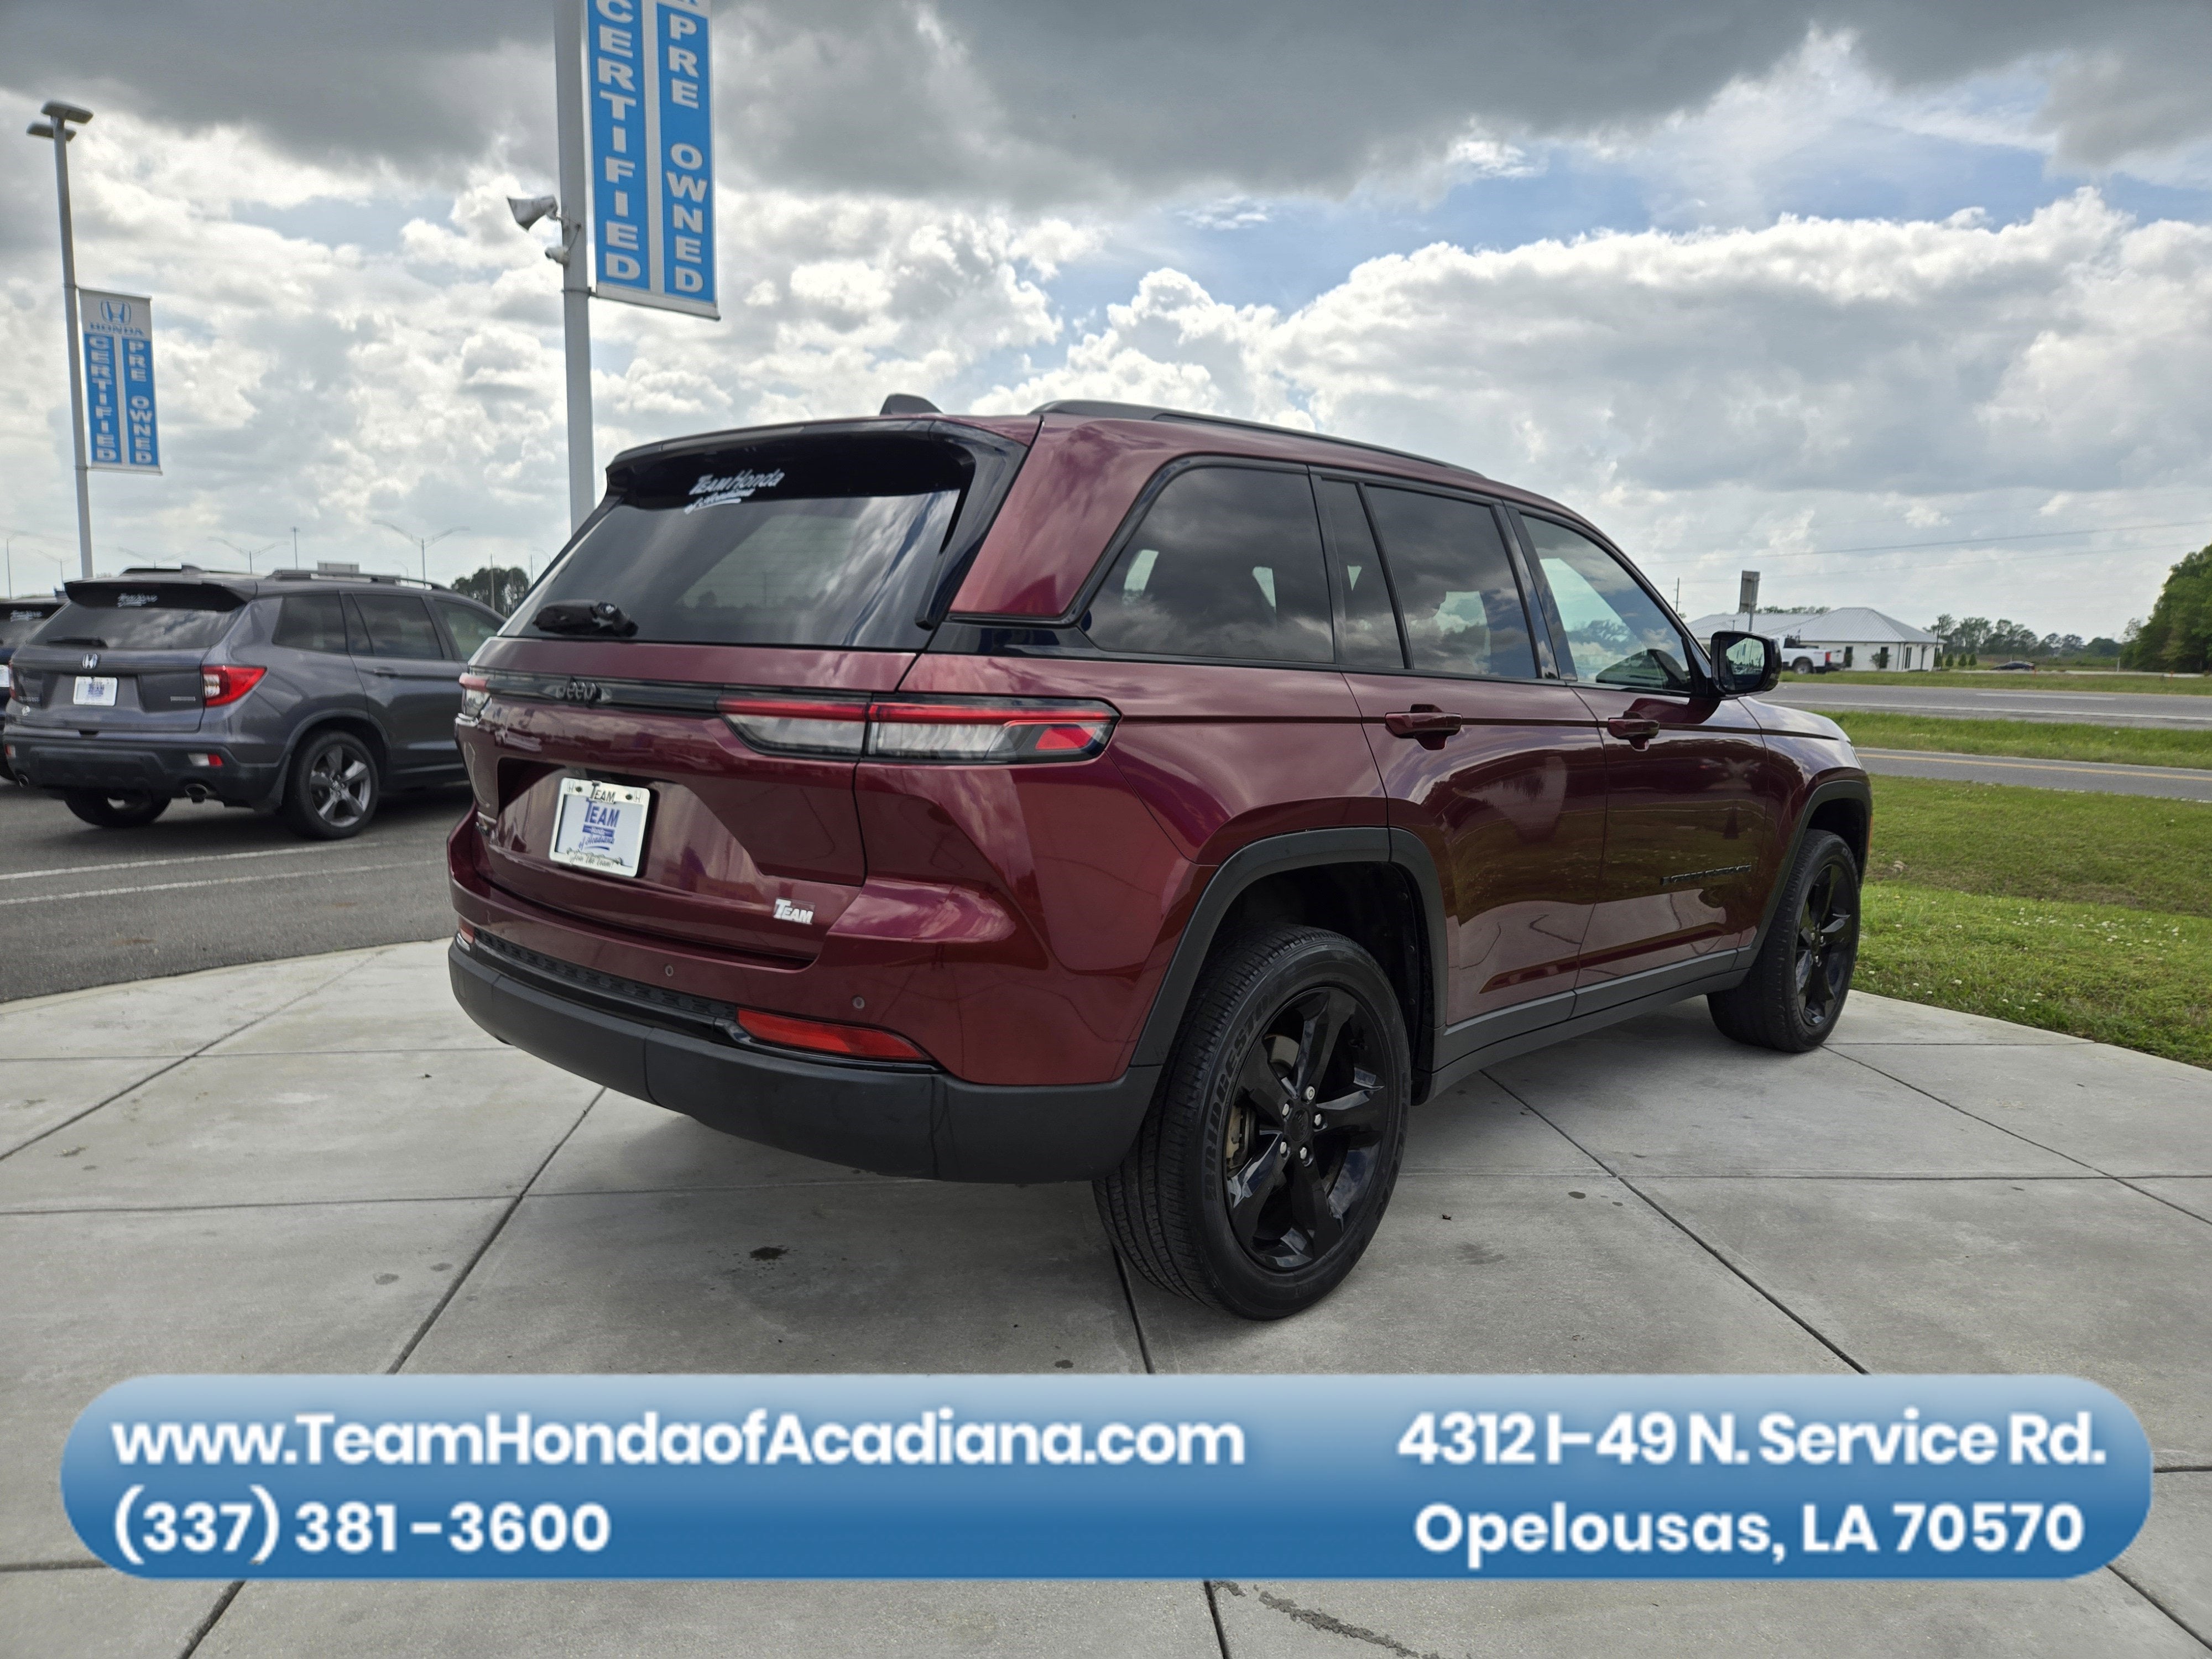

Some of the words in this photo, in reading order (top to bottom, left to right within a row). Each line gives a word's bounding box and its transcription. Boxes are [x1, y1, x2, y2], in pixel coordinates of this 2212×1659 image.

[667, 13, 699, 109] PRE
[596, 0, 641, 281] CERTIFIED
[666, 142, 708, 294] OWNED
[128, 340, 147, 382] PRE
[88, 335, 117, 462] CERTIFIED
[129, 395, 153, 465] OWNED
[585, 797, 620, 828] TEAM
[590, 783, 616, 805] TEAM
[773, 898, 813, 925] TEAM
